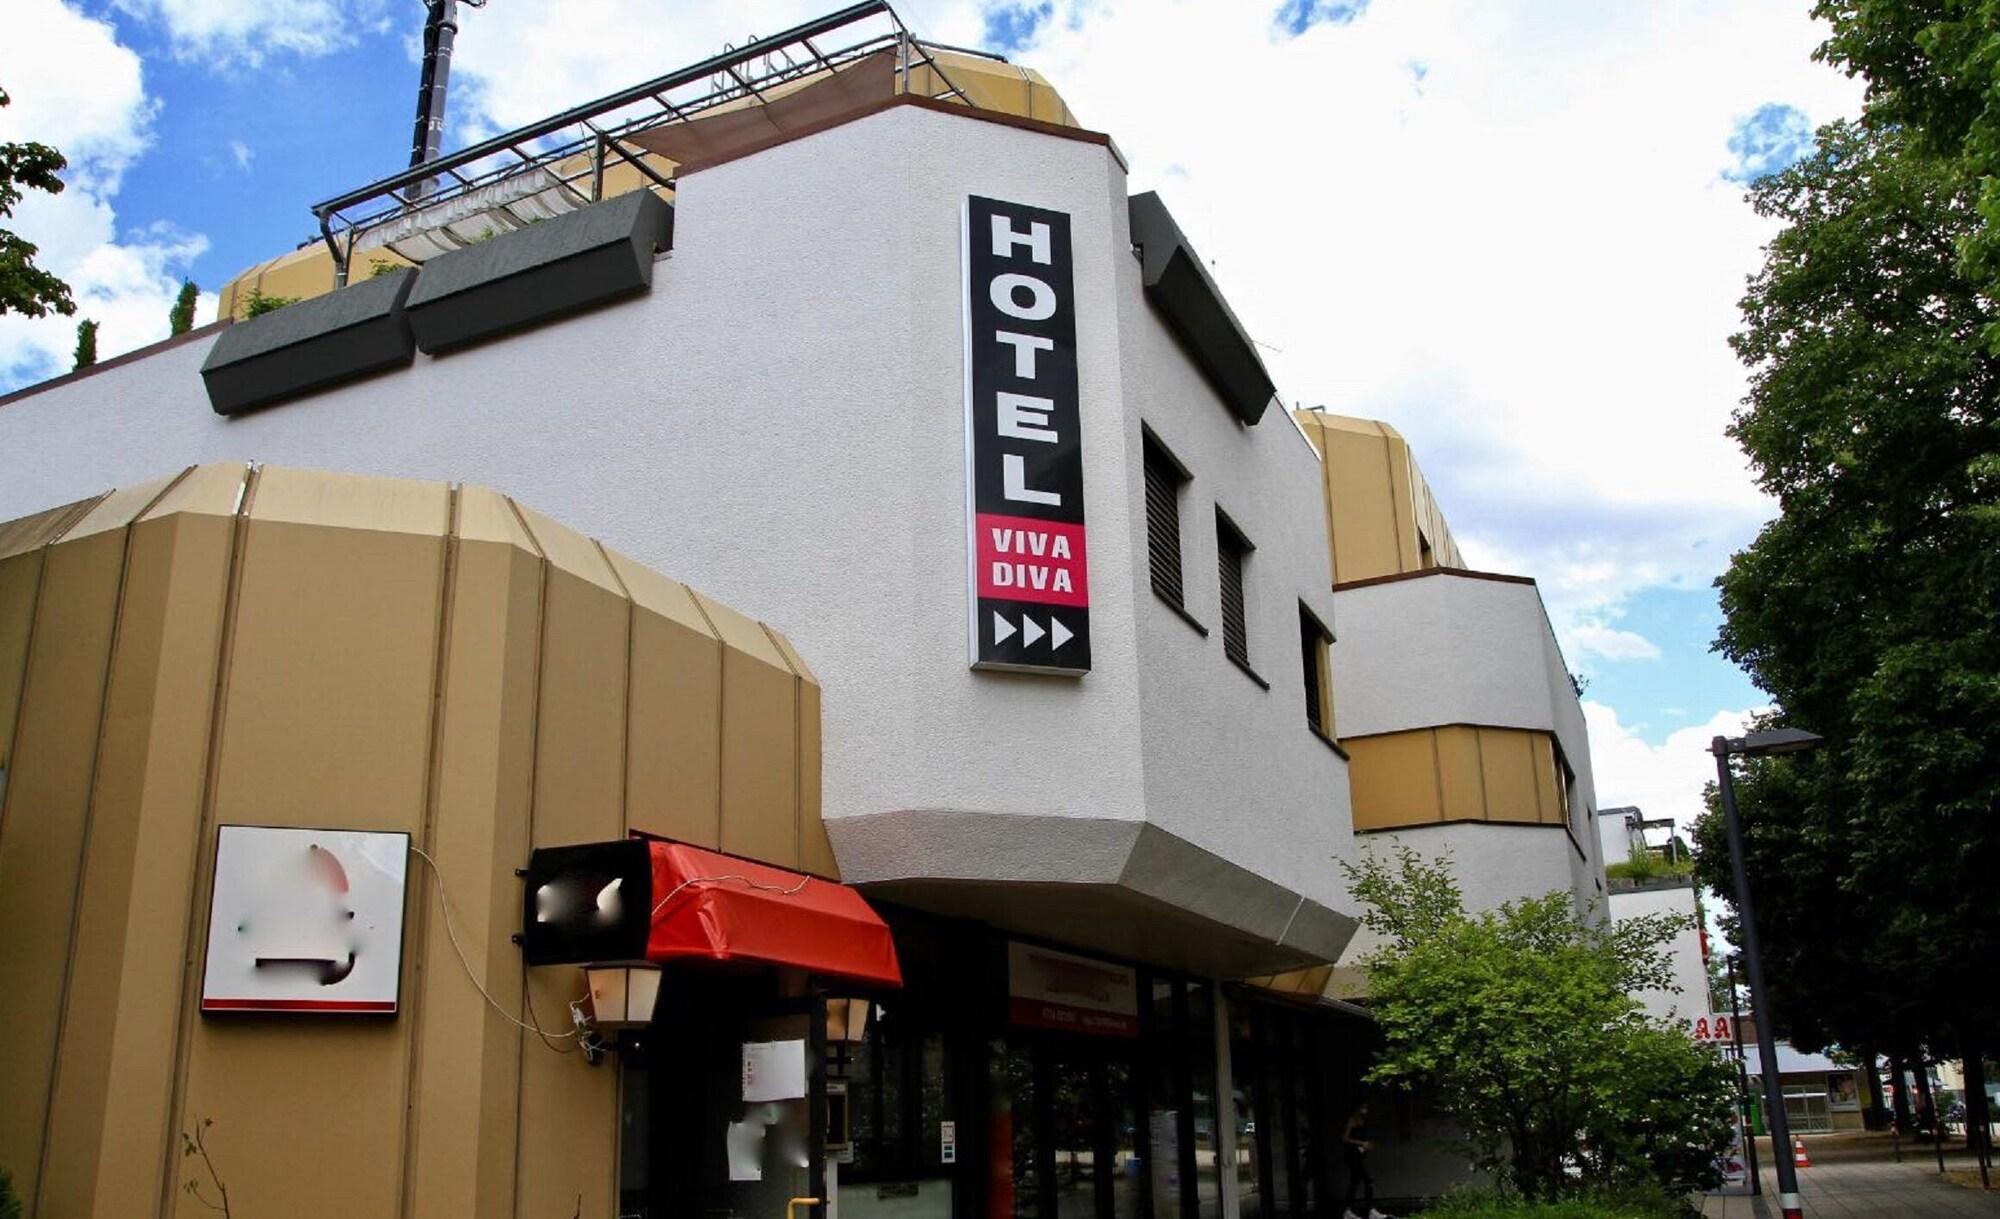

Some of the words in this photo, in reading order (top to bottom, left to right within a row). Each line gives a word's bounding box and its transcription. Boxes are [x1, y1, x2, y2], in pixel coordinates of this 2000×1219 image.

[990, 214, 1061, 506] HOTEL
[992, 528, 1071, 560] VIVA
[992, 562, 1073, 593] DIVA
